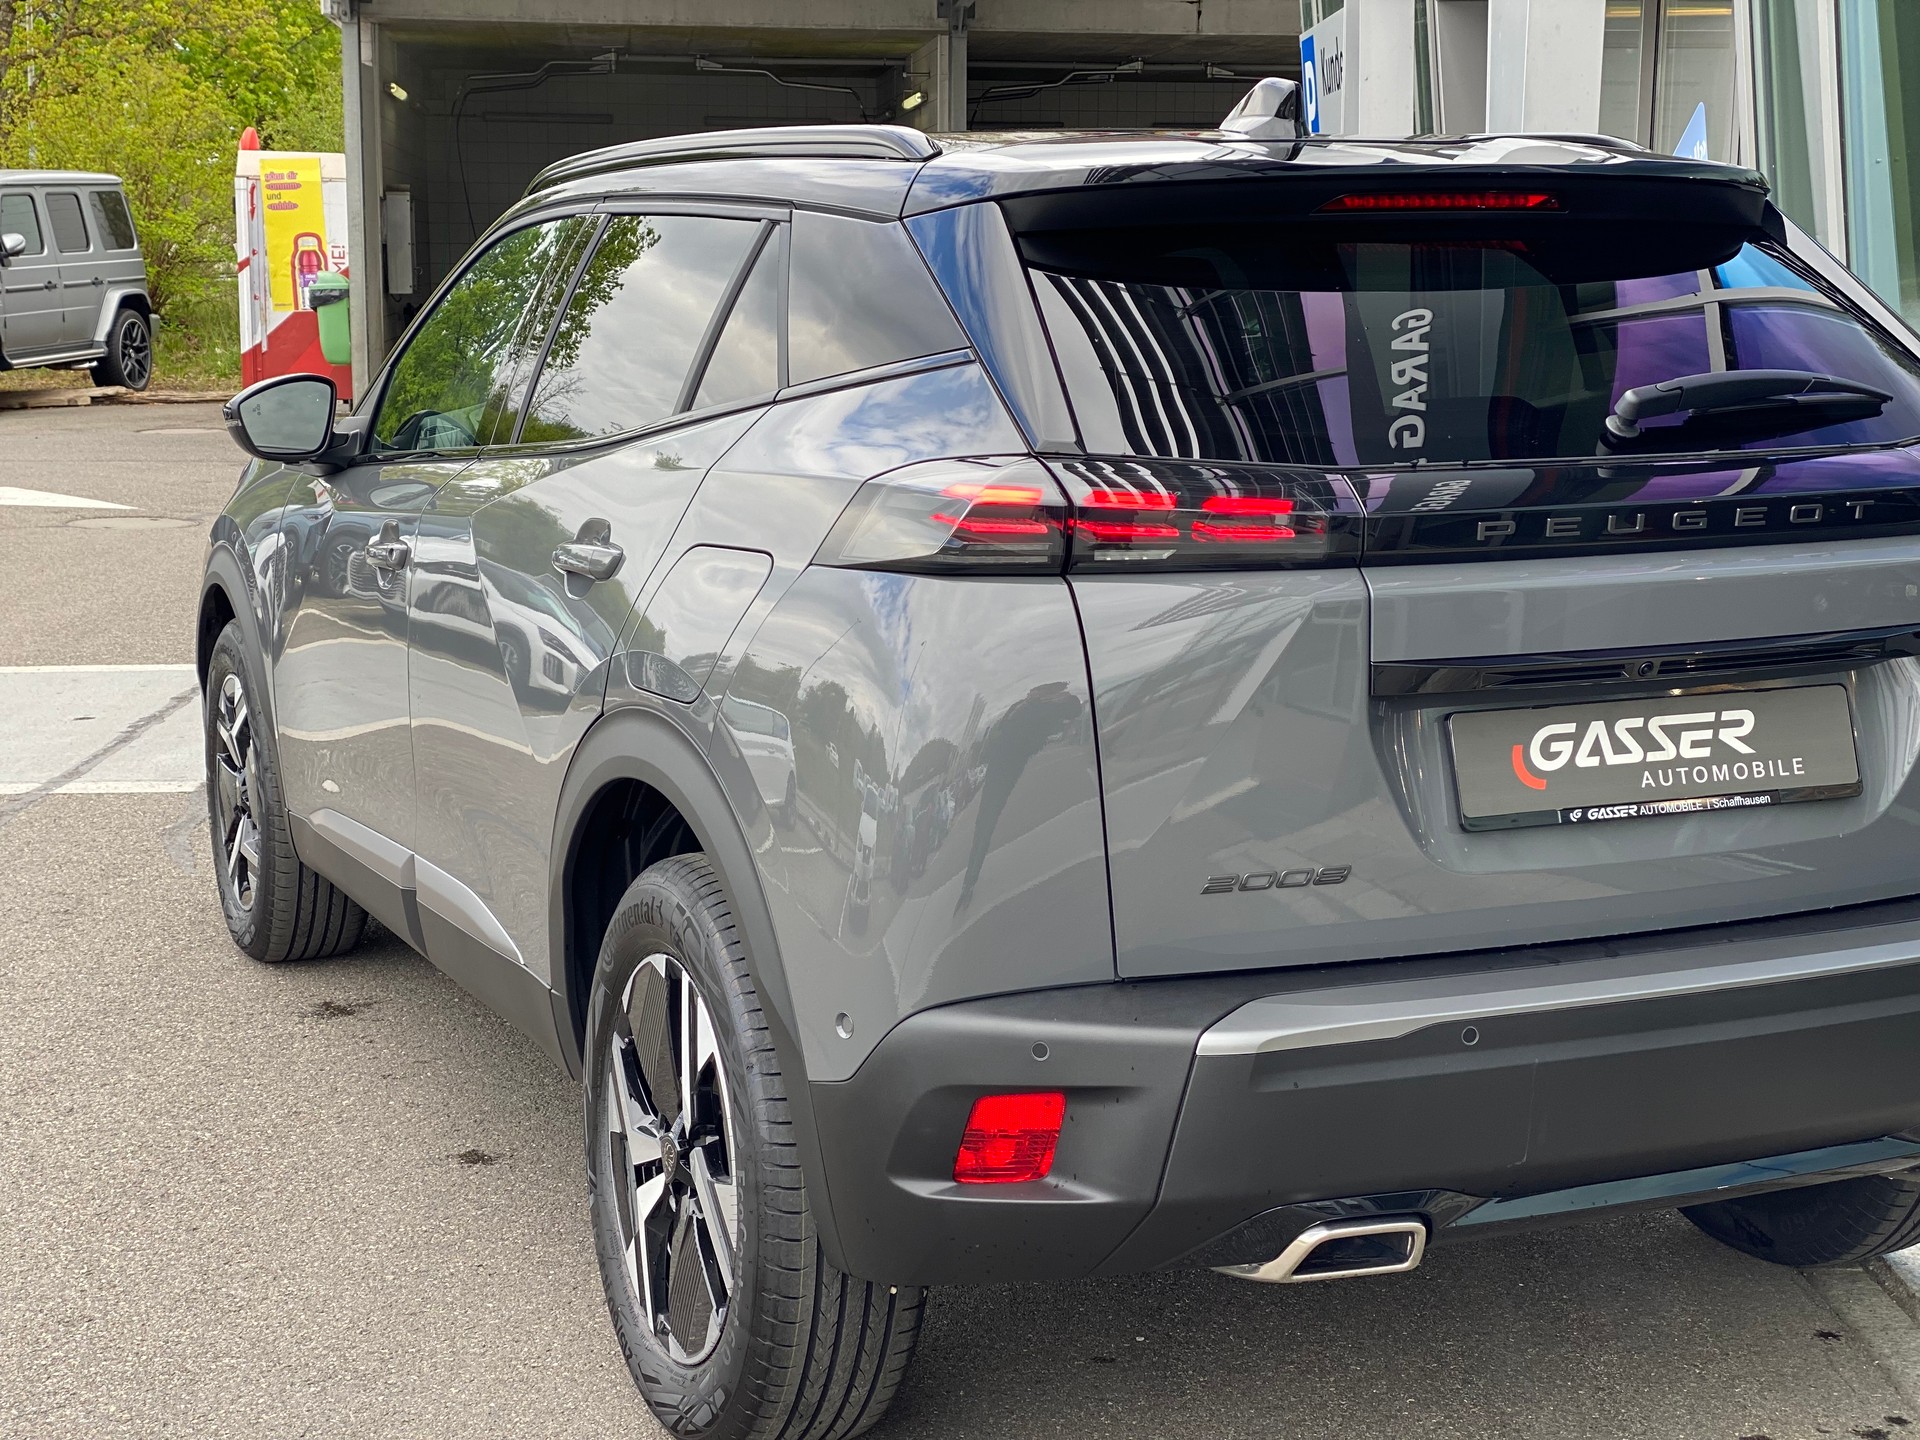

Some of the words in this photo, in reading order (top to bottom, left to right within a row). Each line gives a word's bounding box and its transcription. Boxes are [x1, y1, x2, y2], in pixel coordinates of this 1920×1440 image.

[266, 192, 282, 201] und
[1476, 499, 1875, 541] PEUGEOT
[1529, 708, 1757, 772] GASSER
[1640, 756, 1806, 788] AUTOMOBILE
[1587, 804, 1638, 821] GASSER
[1639, 800, 1703, 817] AUTOMOBILE
[1712, 794, 1772, 810] Schaffhausen
[1200, 864, 1352, 896] 2008
